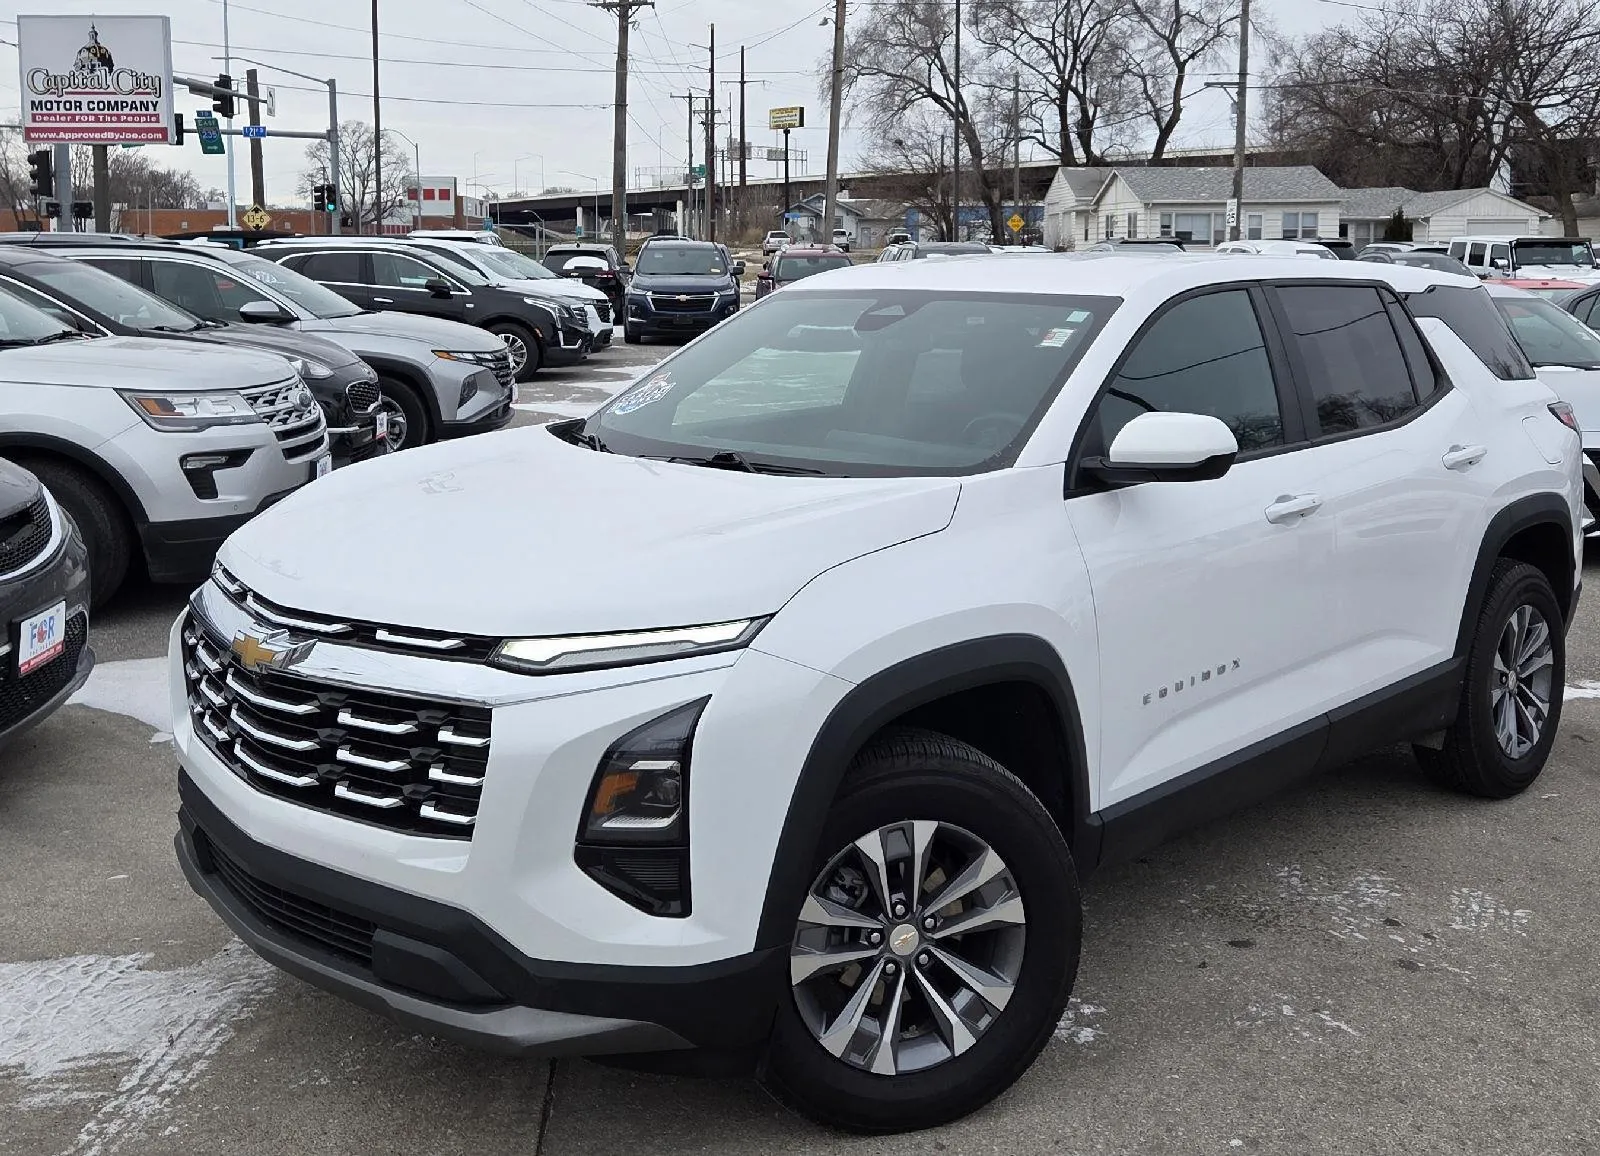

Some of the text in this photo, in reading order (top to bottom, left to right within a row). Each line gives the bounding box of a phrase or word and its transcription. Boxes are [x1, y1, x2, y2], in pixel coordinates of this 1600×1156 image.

[27, 67, 162, 98] Capital City
[30, 100, 159, 112] MOTOR COMPANY
[97, 114, 118, 122] The
[30, 131, 163, 140] www.ApprovedByJoe.com
[202, 130, 218, 139] 235
[1142, 658, 1241, 706] EQUINOX
